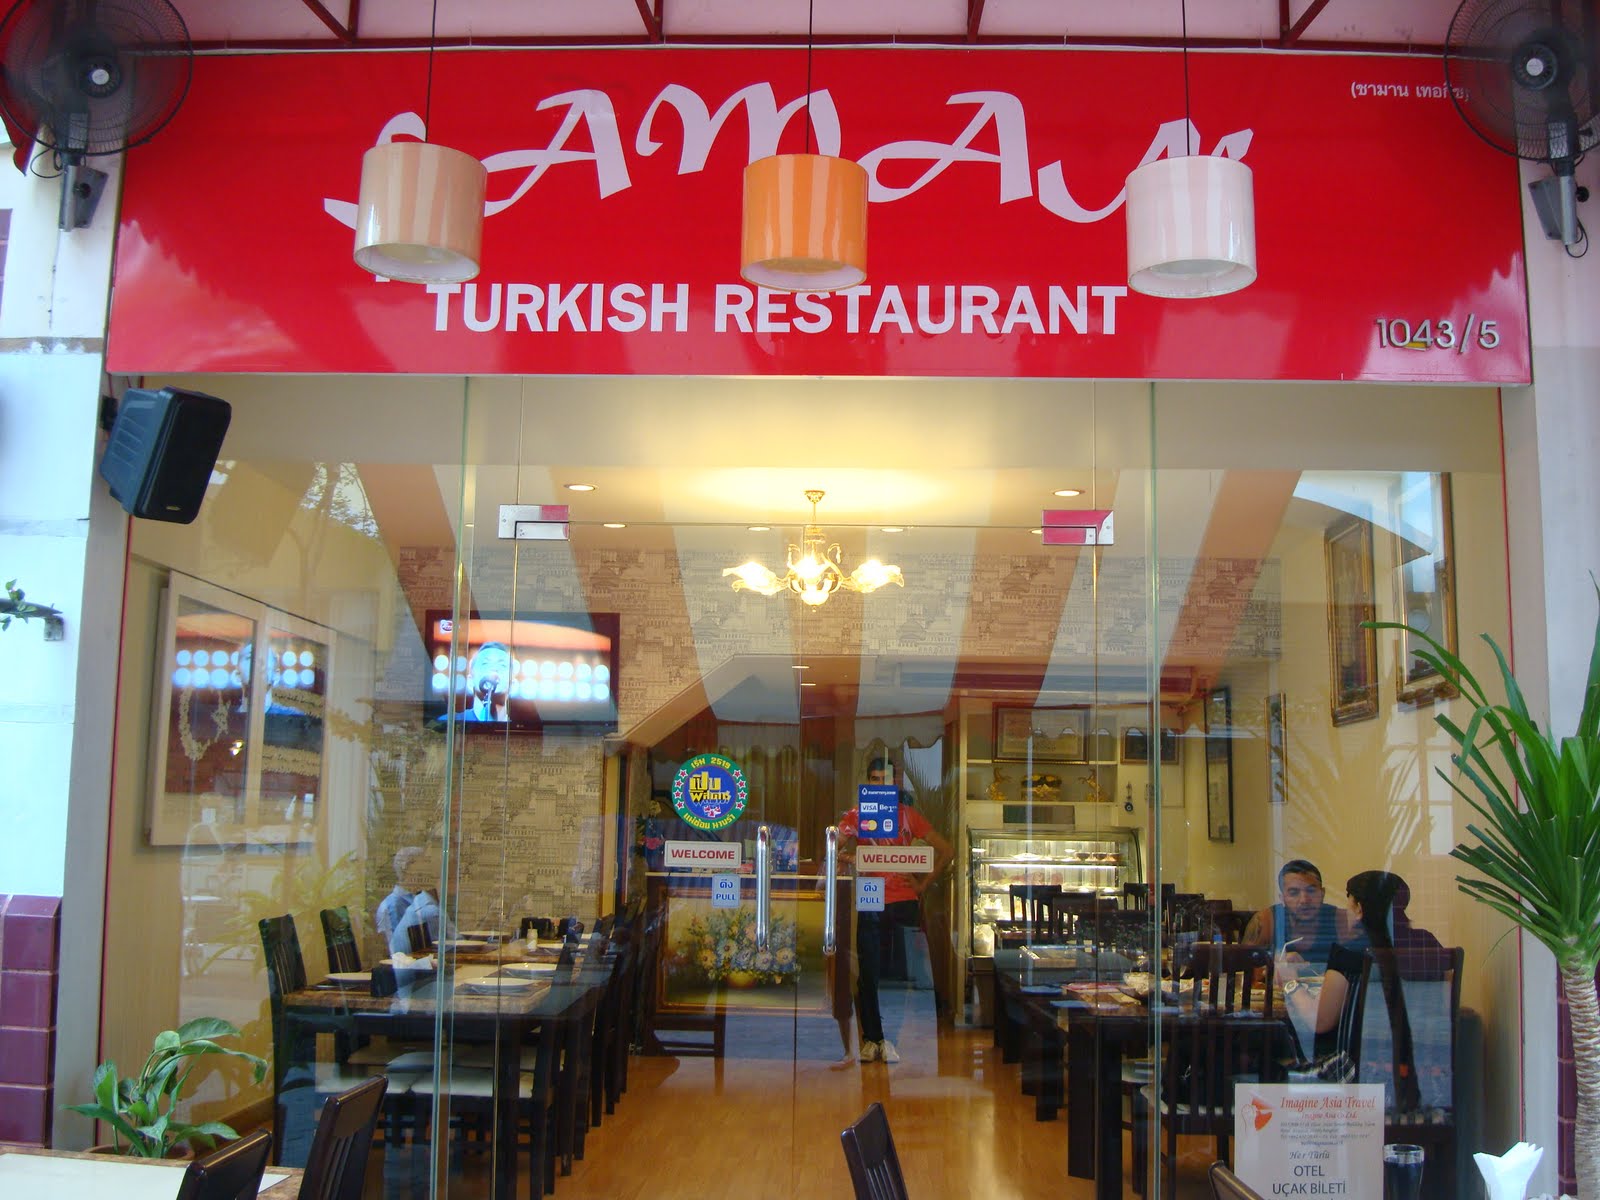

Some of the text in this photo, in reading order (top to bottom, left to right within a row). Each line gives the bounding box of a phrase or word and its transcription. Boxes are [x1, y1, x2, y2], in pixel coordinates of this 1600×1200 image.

[1350, 81, 1409, 98] (ชามาน
[426, 283, 1128, 336] TURKISH RESTAURANT
[1376, 313, 1500, 354] 1043/5
[710, 757, 731, 769] 2519
[671, 849, 735, 860] WELCOME
[862, 853, 927, 864] WELCOME
[719, 879, 733, 889] ดึง
[863, 882, 877, 892] ดึง
[715, 893, 736, 901] PULL
[860, 896, 880, 904] PULL
[1280, 1096, 1376, 1112] Imagine Asia Travel
[1293, 1165, 1325, 1177] OTEL
[1272, 1180, 1346, 1198] UÇAK BİLETİ
